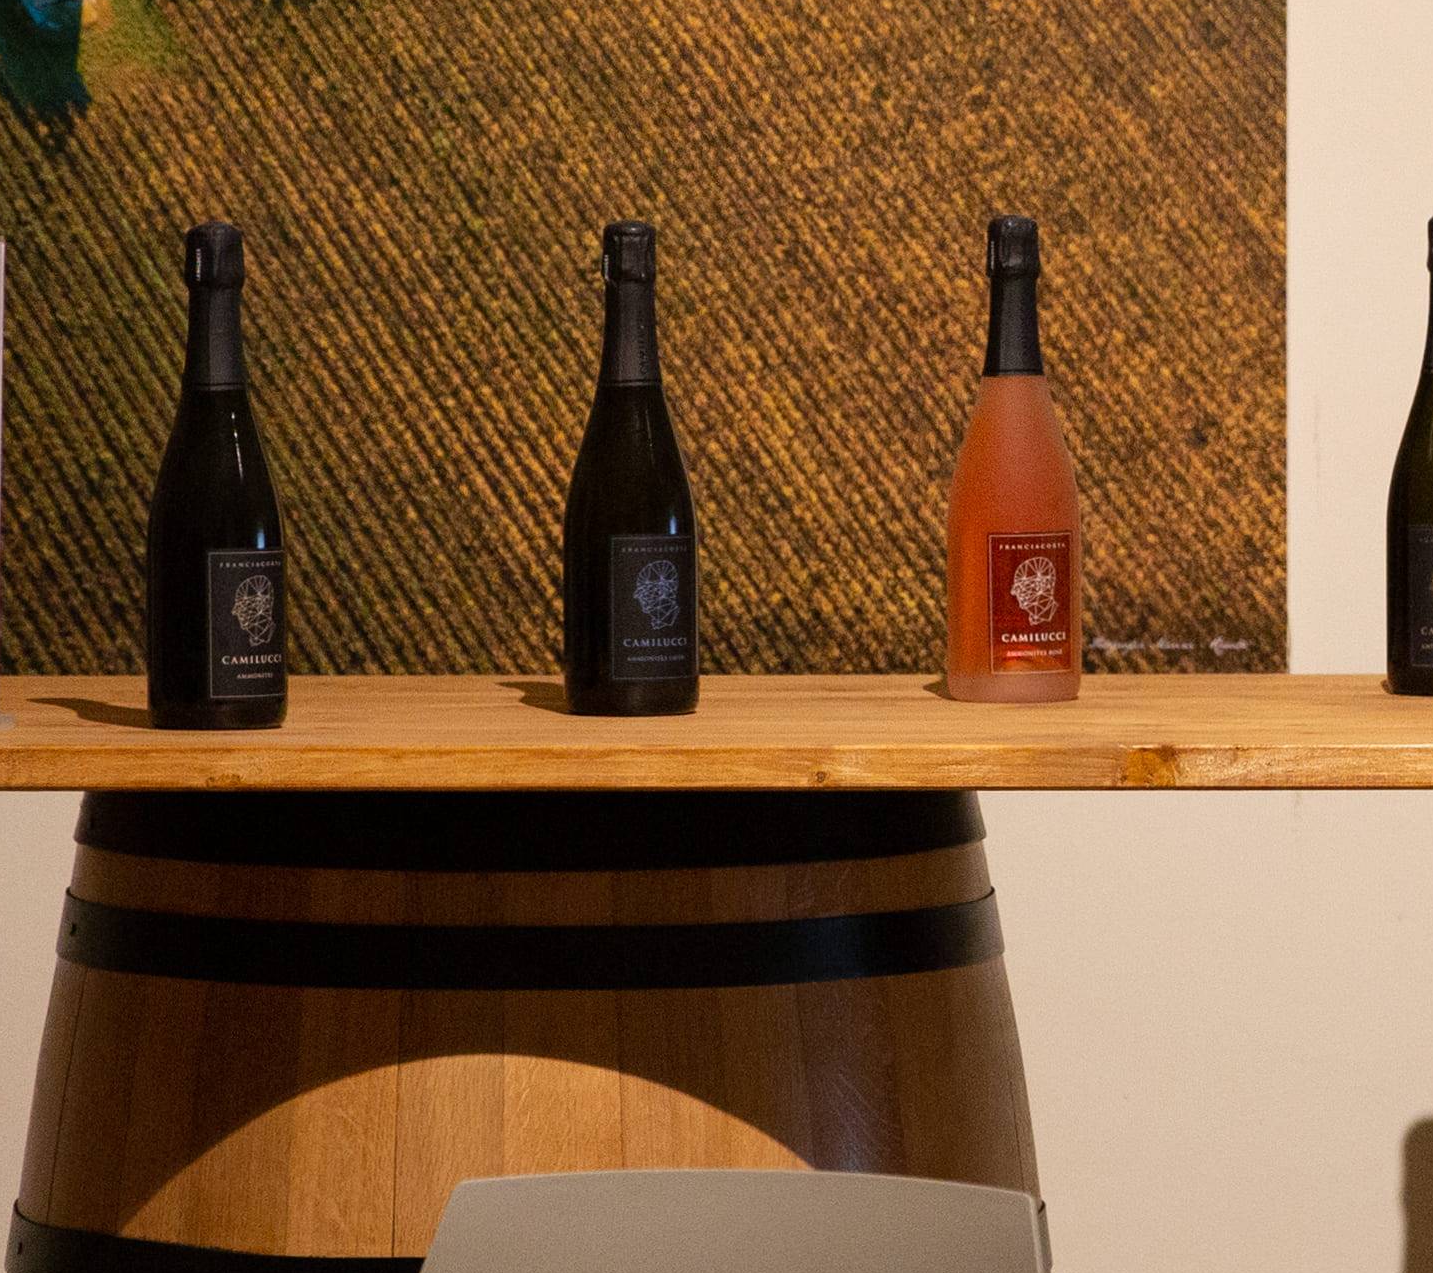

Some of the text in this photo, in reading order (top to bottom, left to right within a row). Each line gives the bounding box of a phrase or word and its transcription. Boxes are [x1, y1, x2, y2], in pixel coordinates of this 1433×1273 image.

[622, 636, 688, 649] CAMILUCCI
[1000, 630, 1067, 644] CAMILUCCI
[221, 653, 282, 666] CAMILUCCI
